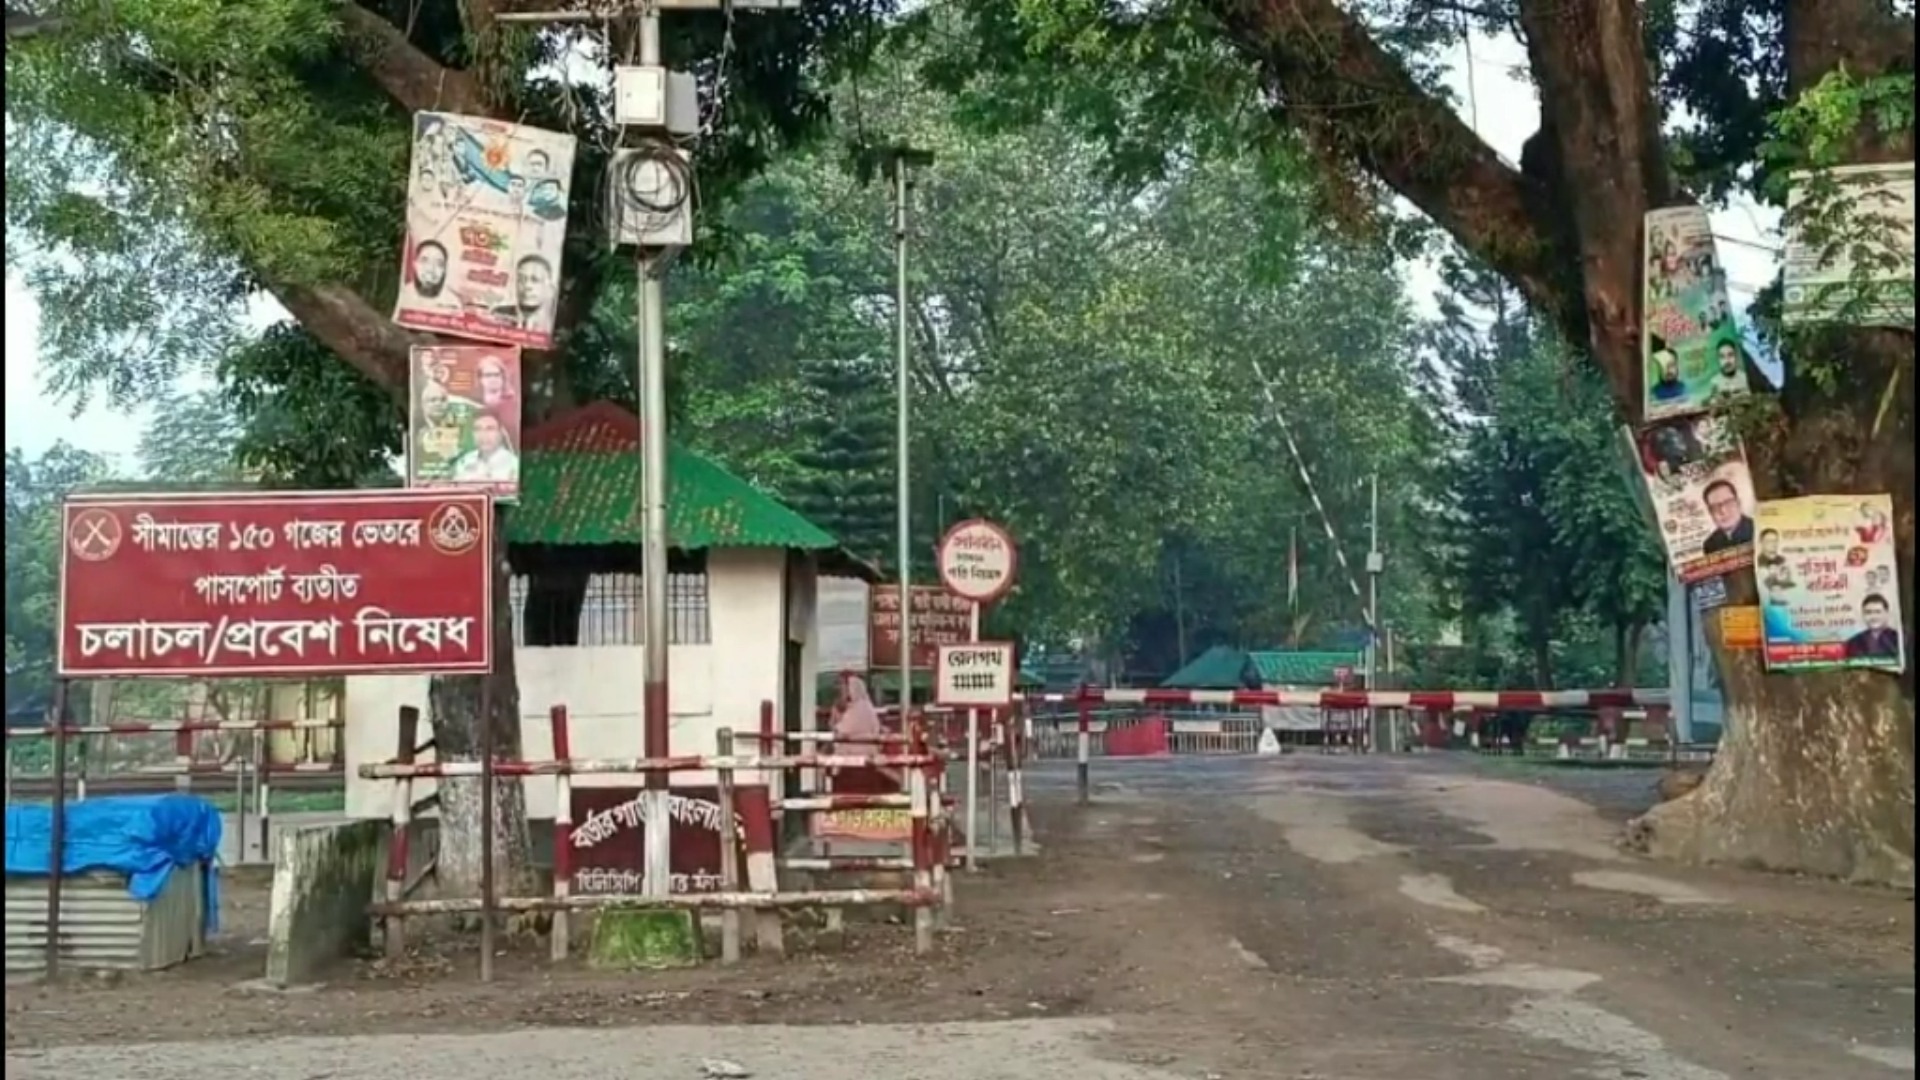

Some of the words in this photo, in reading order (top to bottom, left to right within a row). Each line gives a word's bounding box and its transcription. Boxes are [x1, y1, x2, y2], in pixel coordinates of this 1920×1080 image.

[132, 513, 222, 552] সীমান্তের
[228, 521, 275, 551] ১৫০
[283, 518, 343, 550] গজের
[351, 518, 422, 547] ভেতরে
[194, 567, 287, 605] পাসপোর্ট
[291, 565, 360, 604] ব্যতীত
[75, 614, 343, 664] চলাচল/প্রবেশ
[352, 606, 474, 656] নিষেধ
[569, 808, 618, 848] বর্ডার
